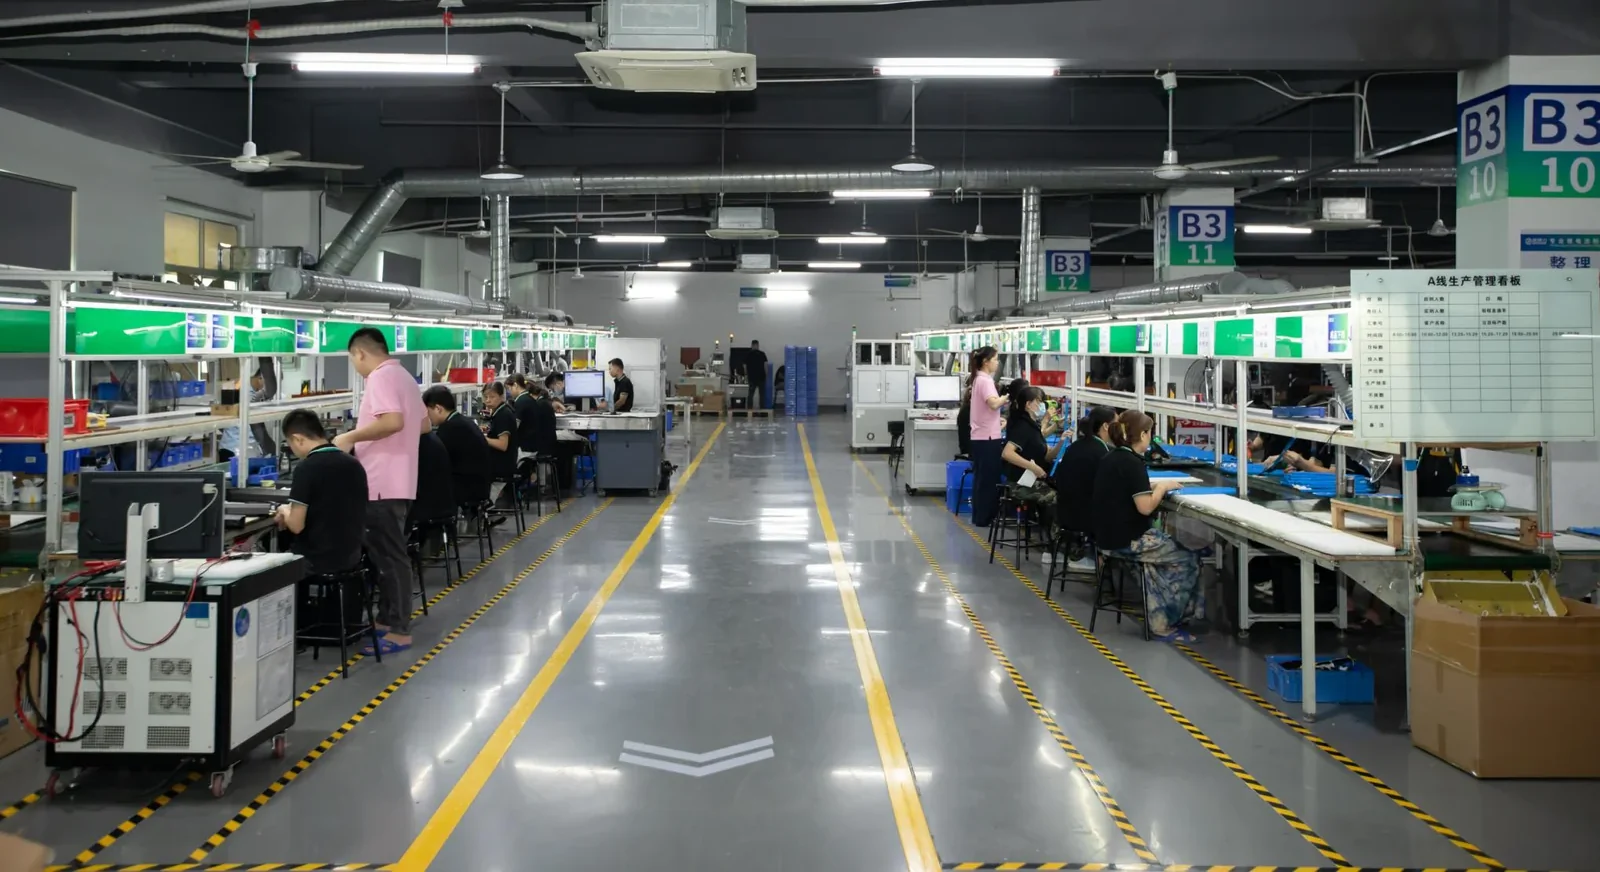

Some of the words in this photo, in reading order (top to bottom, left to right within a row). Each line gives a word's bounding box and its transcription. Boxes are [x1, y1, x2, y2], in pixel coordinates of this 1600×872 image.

[1465, 104, 1502, 157] B3
[1531, 98, 1600, 146] B3
[1468, 161, 1497, 201] 10
[1540, 156, 1596, 194] 10
[1182, 212, 1221, 239] B3
[1054, 255, 1082, 273] B3
[1187, 243, 1217, 264] 11
[1057, 276, 1078, 291] 12
[1427, 275, 1521, 287] A线生产管理看板
